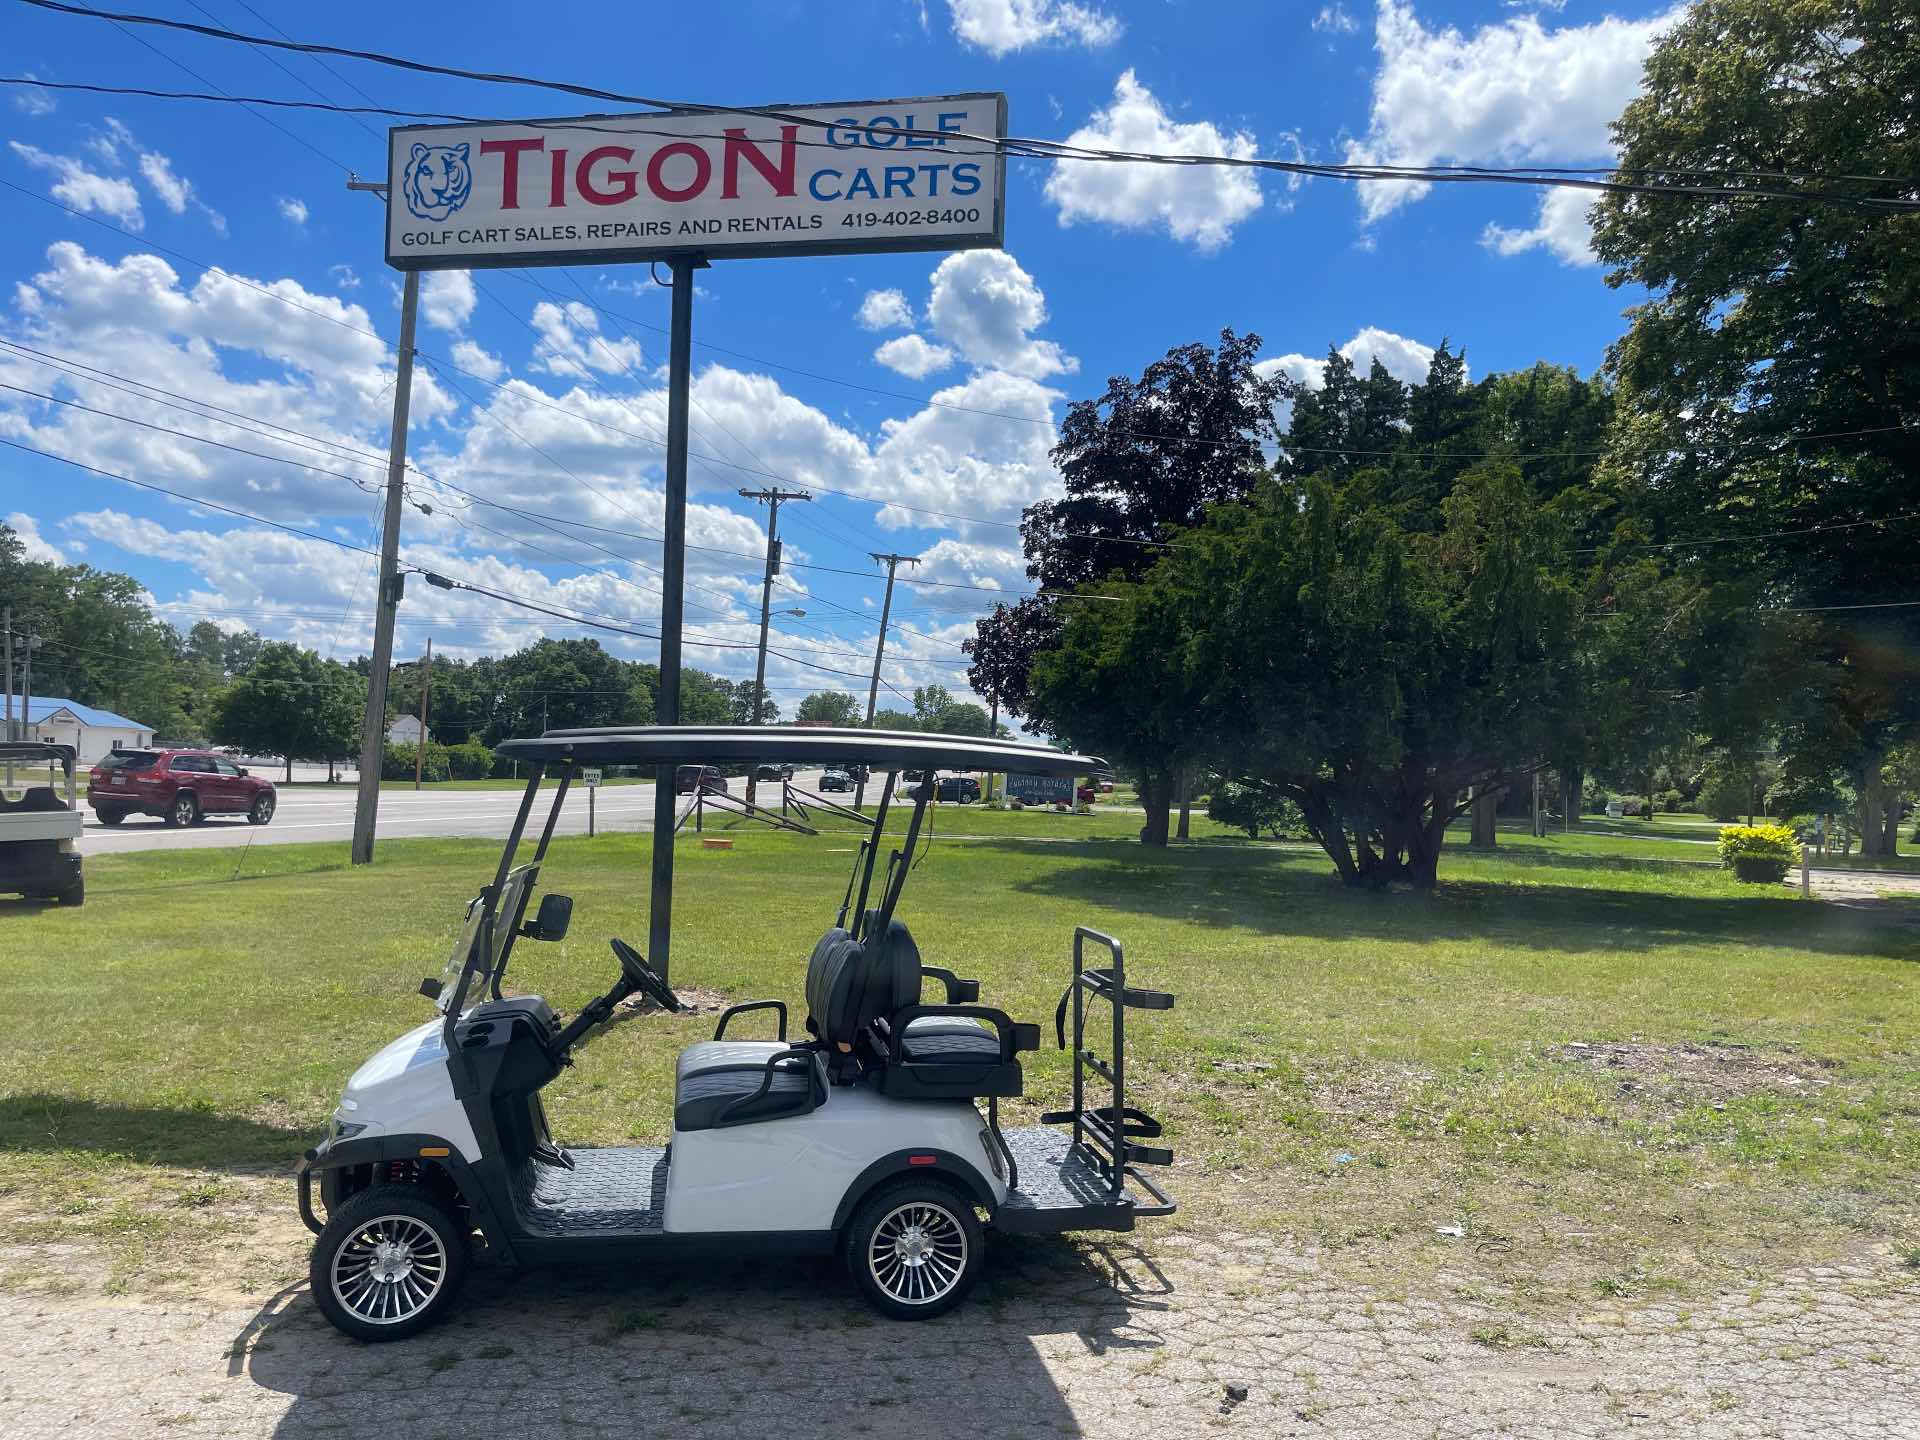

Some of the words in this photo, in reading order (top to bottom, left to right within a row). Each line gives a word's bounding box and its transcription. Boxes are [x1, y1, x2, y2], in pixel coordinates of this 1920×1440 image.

[826, 112, 968, 150] GOLF
[480, 125, 800, 209] TIGON
[808, 163, 982, 201] CARTS
[401, 231, 453, 246] GOLF
[458, 228, 510, 244] CART
[514, 225, 582, 241] SALES,
[586, 220, 672, 239] REPAIRS
[678, 218, 722, 235] AND
[727, 215, 823, 233] RENTALS
[841, 208, 980, 228] 419-402-8400
